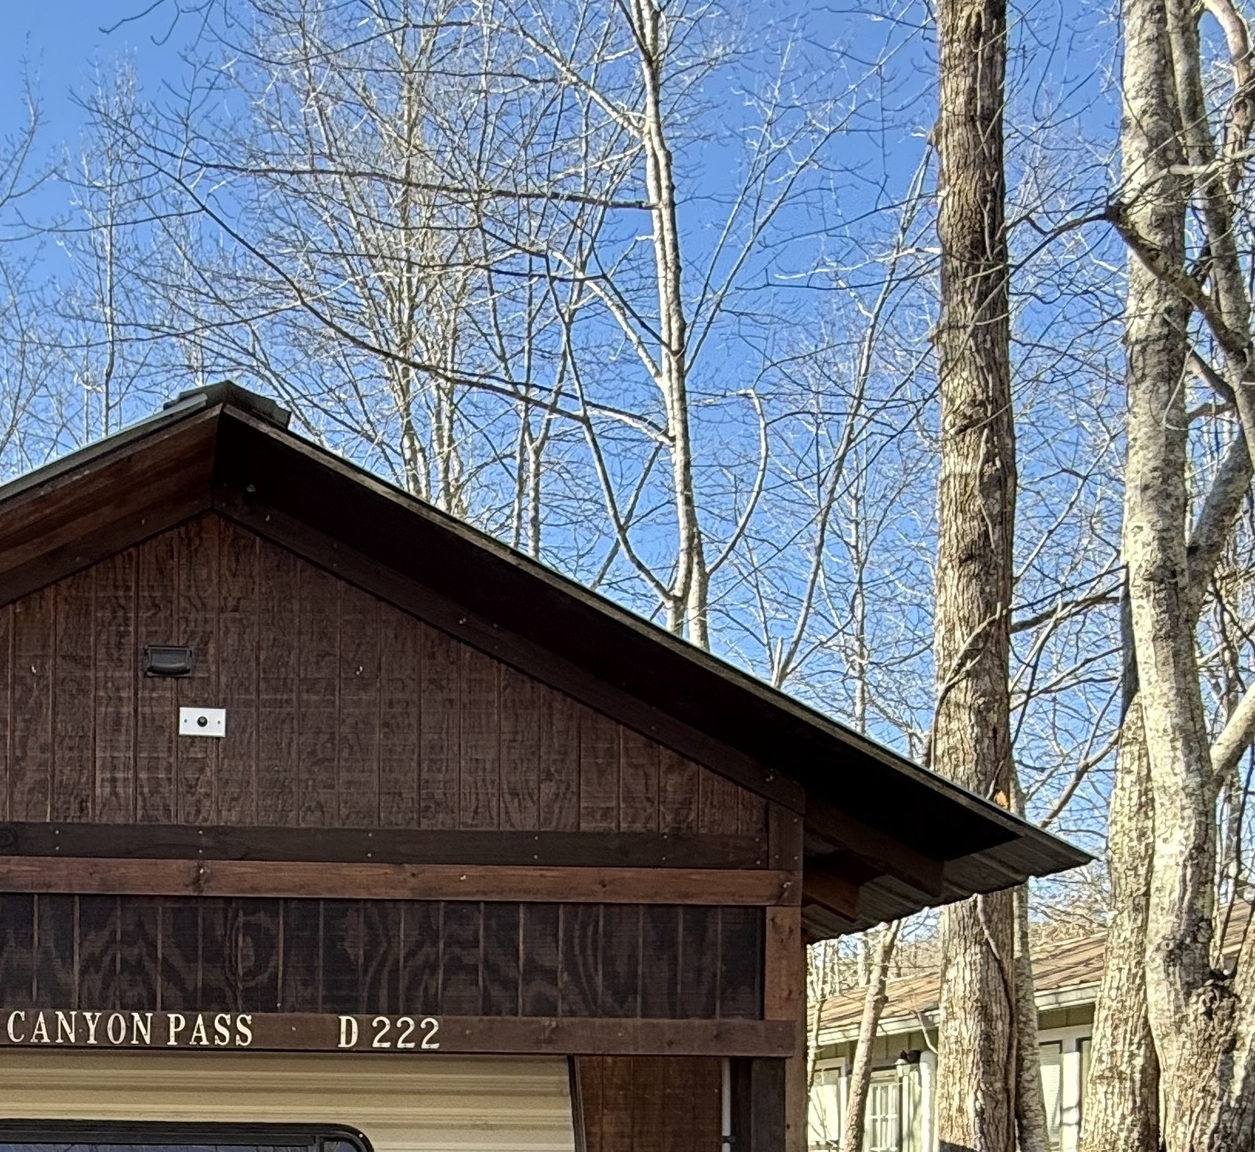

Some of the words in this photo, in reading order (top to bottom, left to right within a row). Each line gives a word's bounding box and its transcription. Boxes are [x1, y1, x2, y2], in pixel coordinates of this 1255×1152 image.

[6, 1010, 154, 1045] CANYON
[166, 1013, 254, 1047] PASS
[337, 1015, 359, 1048] D
[371, 1016, 441, 1049] 222
